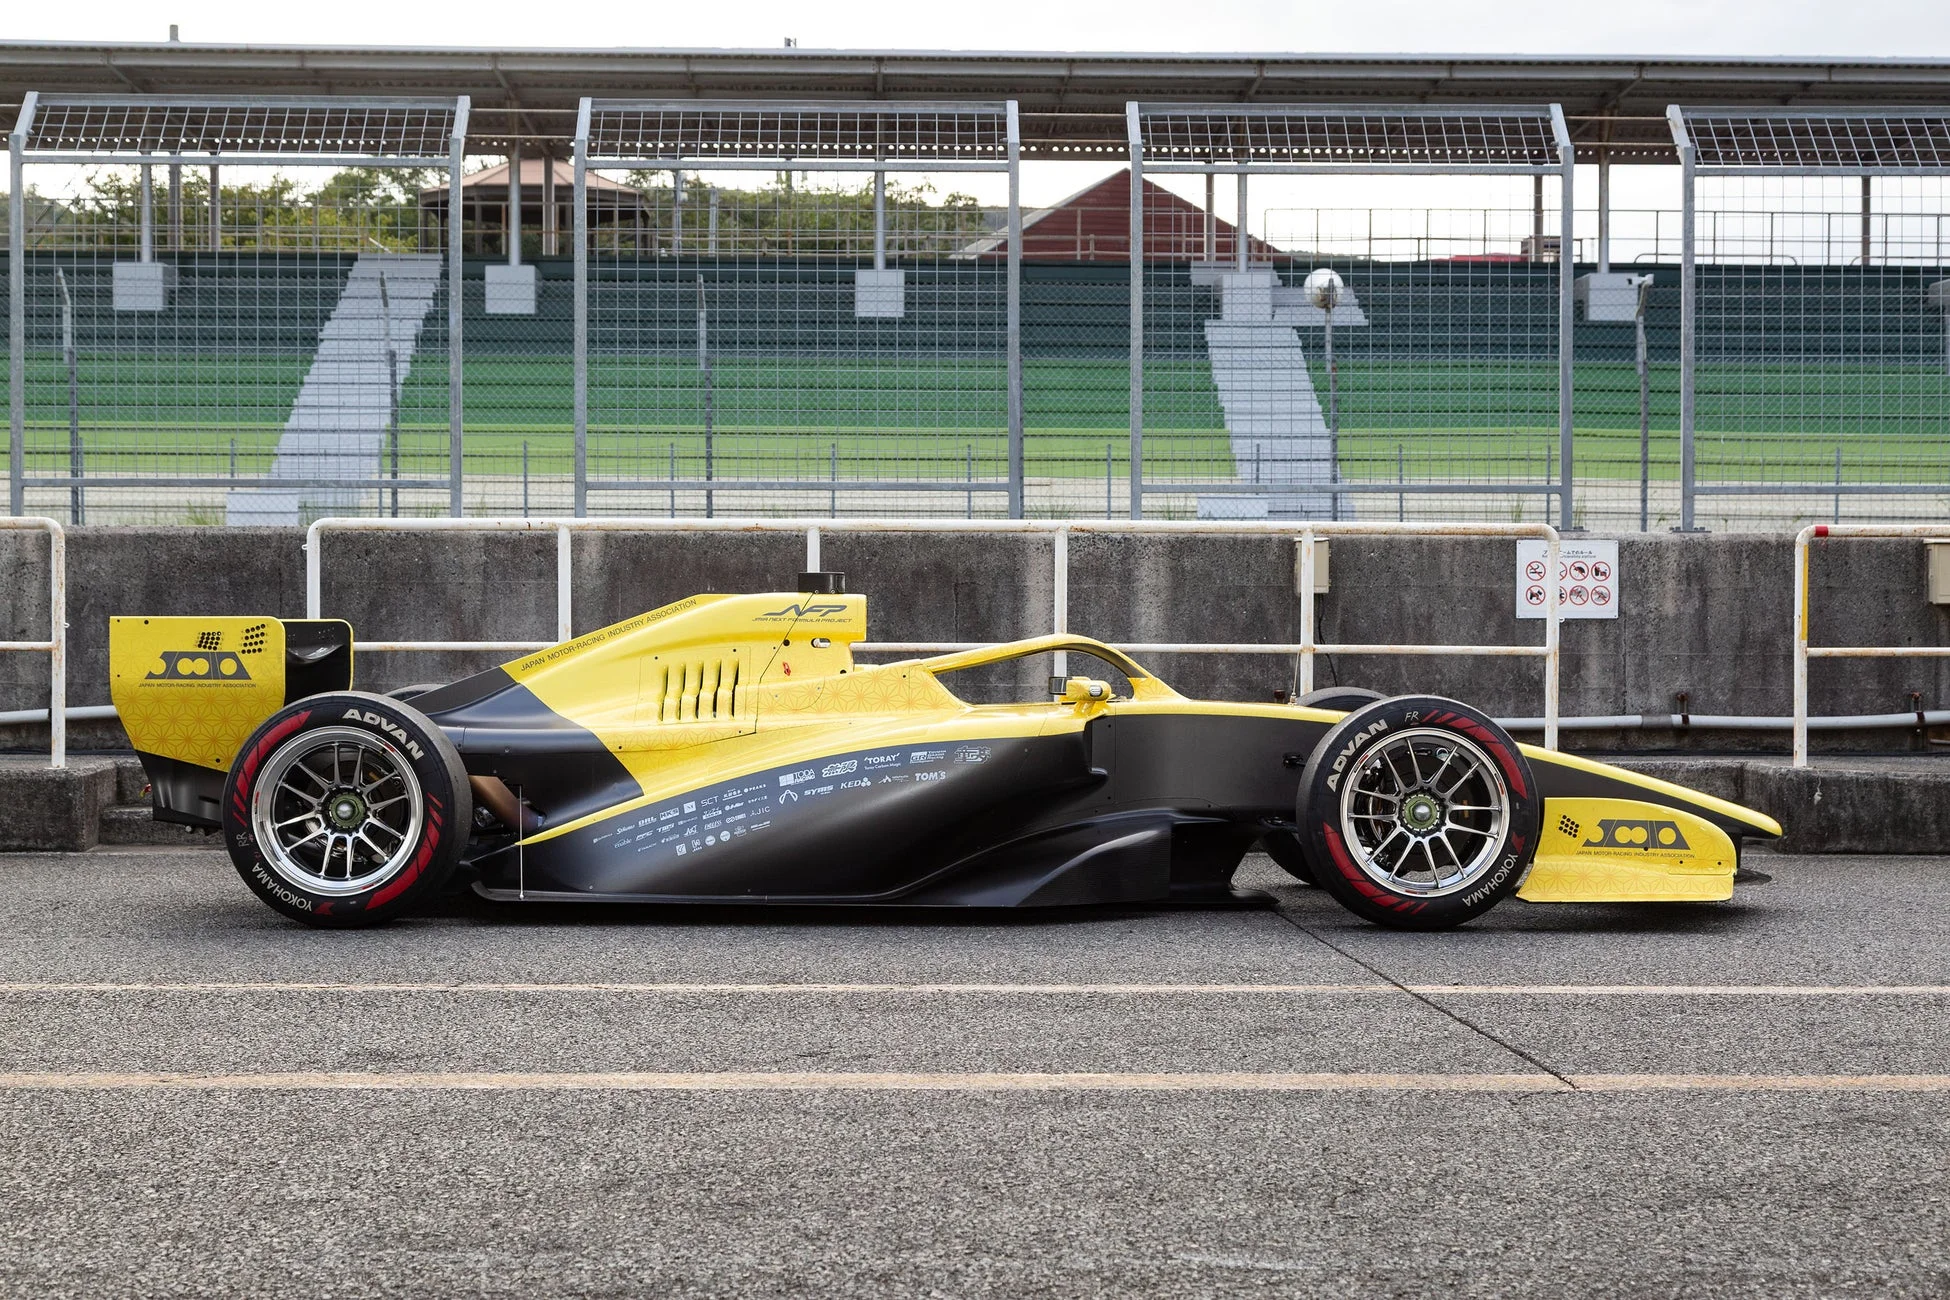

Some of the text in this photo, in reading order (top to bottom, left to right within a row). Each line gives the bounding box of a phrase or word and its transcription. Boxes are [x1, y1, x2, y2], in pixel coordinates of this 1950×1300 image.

[520, 598, 698, 672] JAPAN MOTOR-RACING INDUSTRY ASSOCIATION
[341, 708, 424, 761] ADVAN
[1404, 710, 1420, 723] FR
[914, 770, 947, 782] TOM'S
[1326, 718, 1389, 793] ADVAN
[840, 779, 862, 790] KED
[251, 862, 313, 912] YOKOHAMA
[1461, 853, 1519, 908] YOKOHAMA
